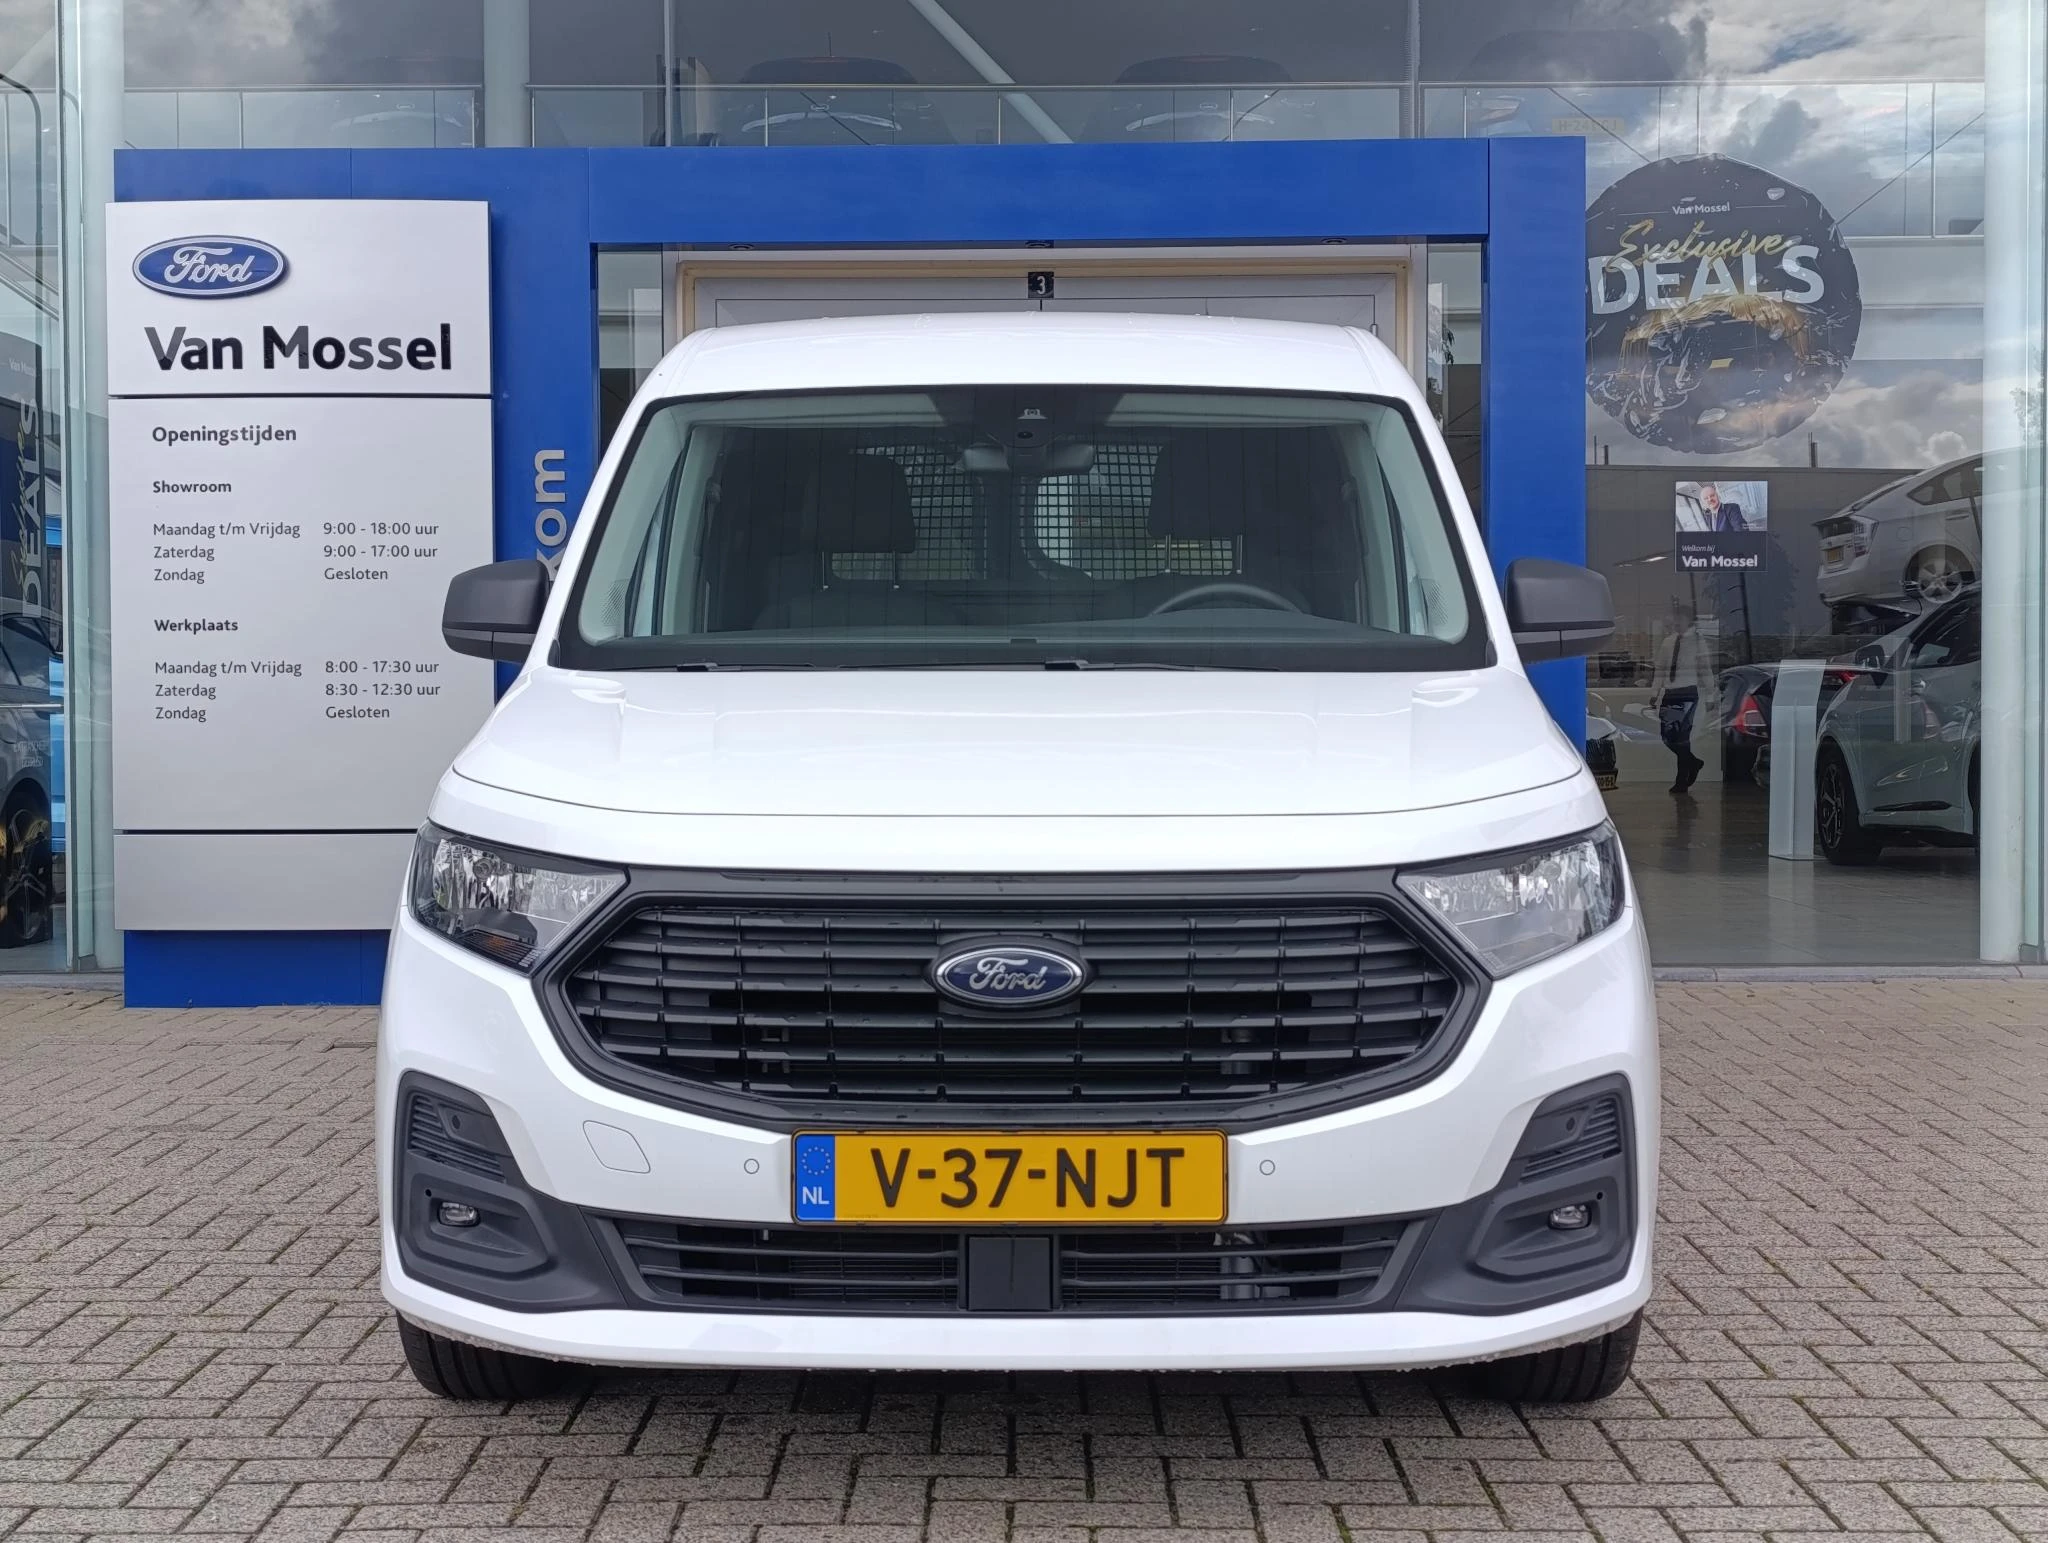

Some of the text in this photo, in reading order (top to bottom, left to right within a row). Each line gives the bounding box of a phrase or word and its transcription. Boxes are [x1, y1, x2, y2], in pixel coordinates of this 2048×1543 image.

[1672, 201, 1731, 216] Van Mossel
[1605, 219, 1792, 272] Exclusive
[163, 245, 255, 284] Ford
[1036, 275, 1046, 295] 3
[1588, 245, 1825, 315] DEALS
[144, 322, 452, 371] Van Mossel
[151, 424, 297, 447] Openingstijden
[152, 480, 232, 494] Showroom
[153, 522, 215, 539] Maandag
[219, 522, 246, 536] t/m
[249, 521, 301, 538] Vrijdag
[323, 522, 357, 535] 9:00
[370, 522, 411, 535] 18:00
[414, 525, 440, 536] uur
[153, 545, 215, 561] Zaterdag
[323, 545, 357, 558] 9:00
[370, 544, 410, 558] 17:00
[413, 547, 439, 558] uur
[1681, 544, 1706, 552] Welkom
[1681, 554, 1758, 568] Van Mossel
[153, 566, 389, 584] Zondag Gesloten
[153, 618, 239, 635] Werkplaats
[154, 661, 218, 677] Maandag
[221, 660, 247, 675] t/m
[251, 660, 303, 677] Vrijdag
[325, 660, 359, 674] 8:00
[372, 660, 412, 674] 17:30
[415, 663, 440, 673] uur
[154, 683, 217, 700] Zaterdag
[325, 683, 358, 696] 8:30
[372, 682, 413, 696] 12:30
[416, 685, 441, 696] uur
[154, 704, 390, 722] Zondag Gesloten
[969, 957, 1049, 991] Ford
[870, 1147, 1185, 1209] V-37-NJT
[801, 1186, 830, 1205] NL
